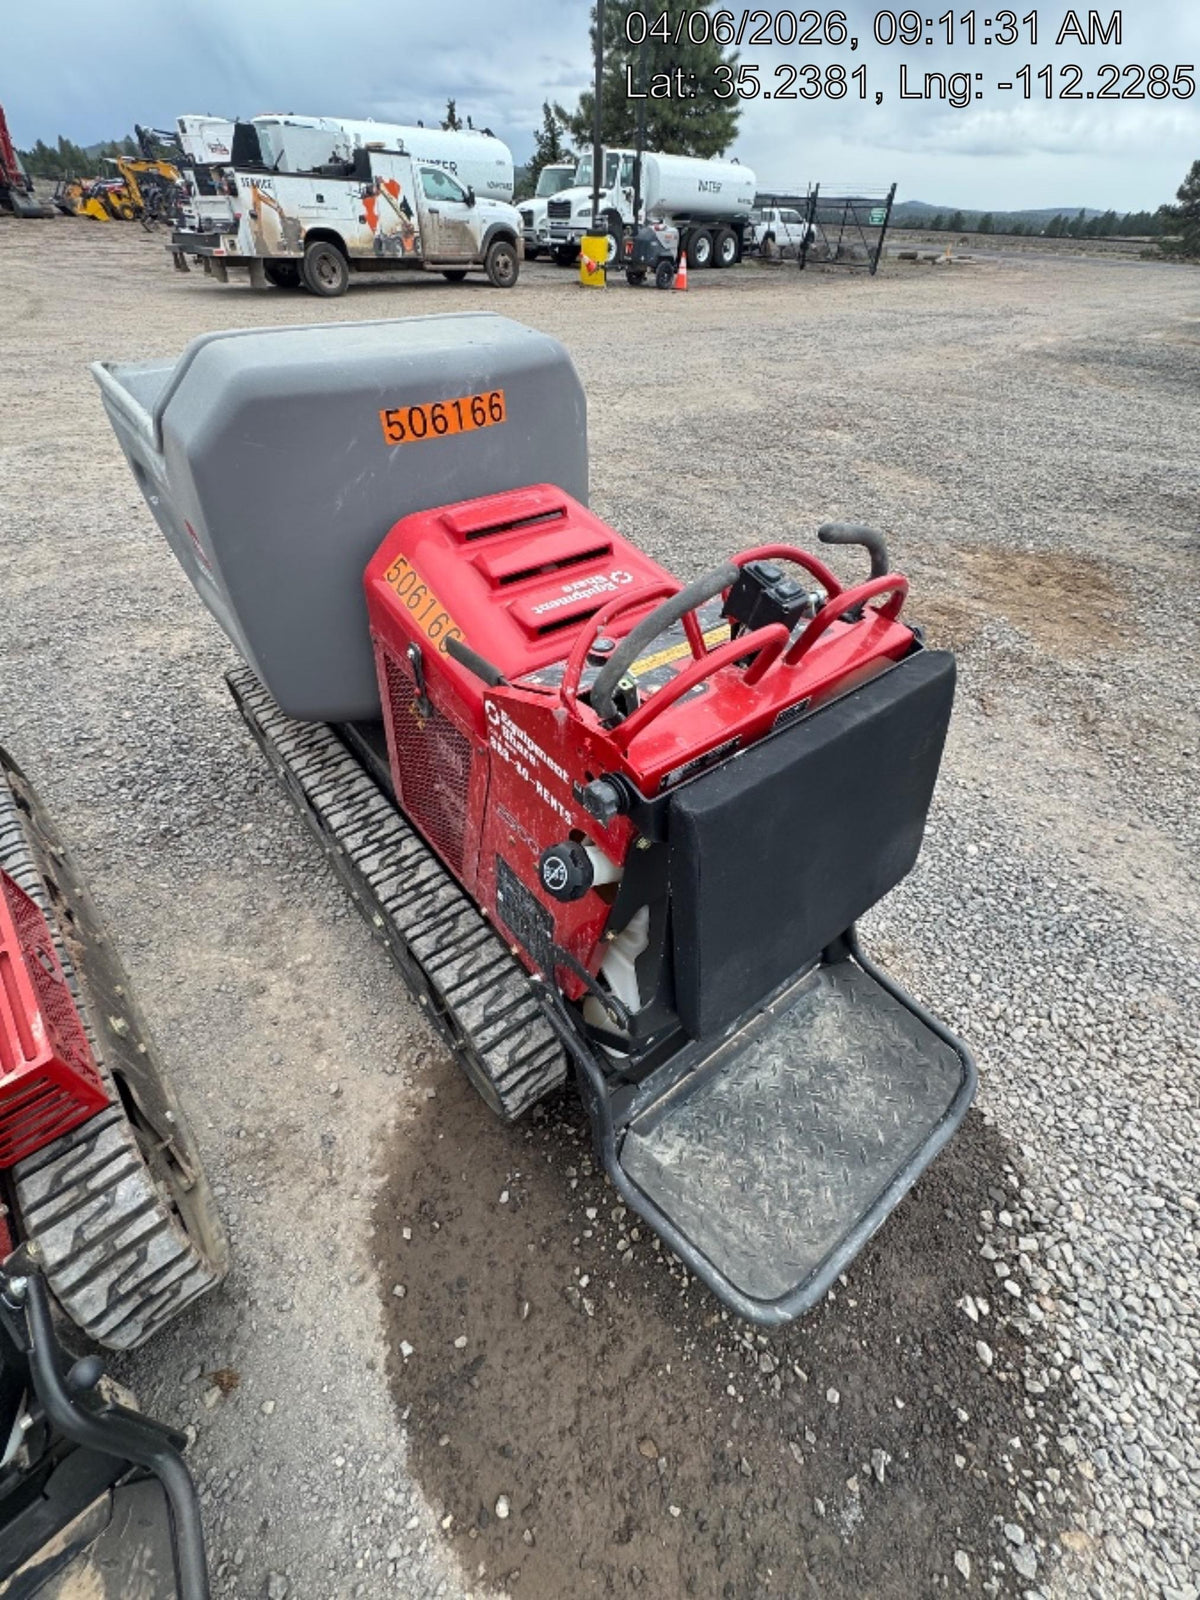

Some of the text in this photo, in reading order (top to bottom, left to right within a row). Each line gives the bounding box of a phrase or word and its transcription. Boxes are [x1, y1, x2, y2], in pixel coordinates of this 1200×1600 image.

[384, 392, 503, 442] 506166
[386, 557, 462, 654] 506166
[531, 582, 619, 615] Equipment
[561, 574, 609, 594] Share
[500, 709, 570, 785] Equipment
[501, 725, 538, 767] Share
